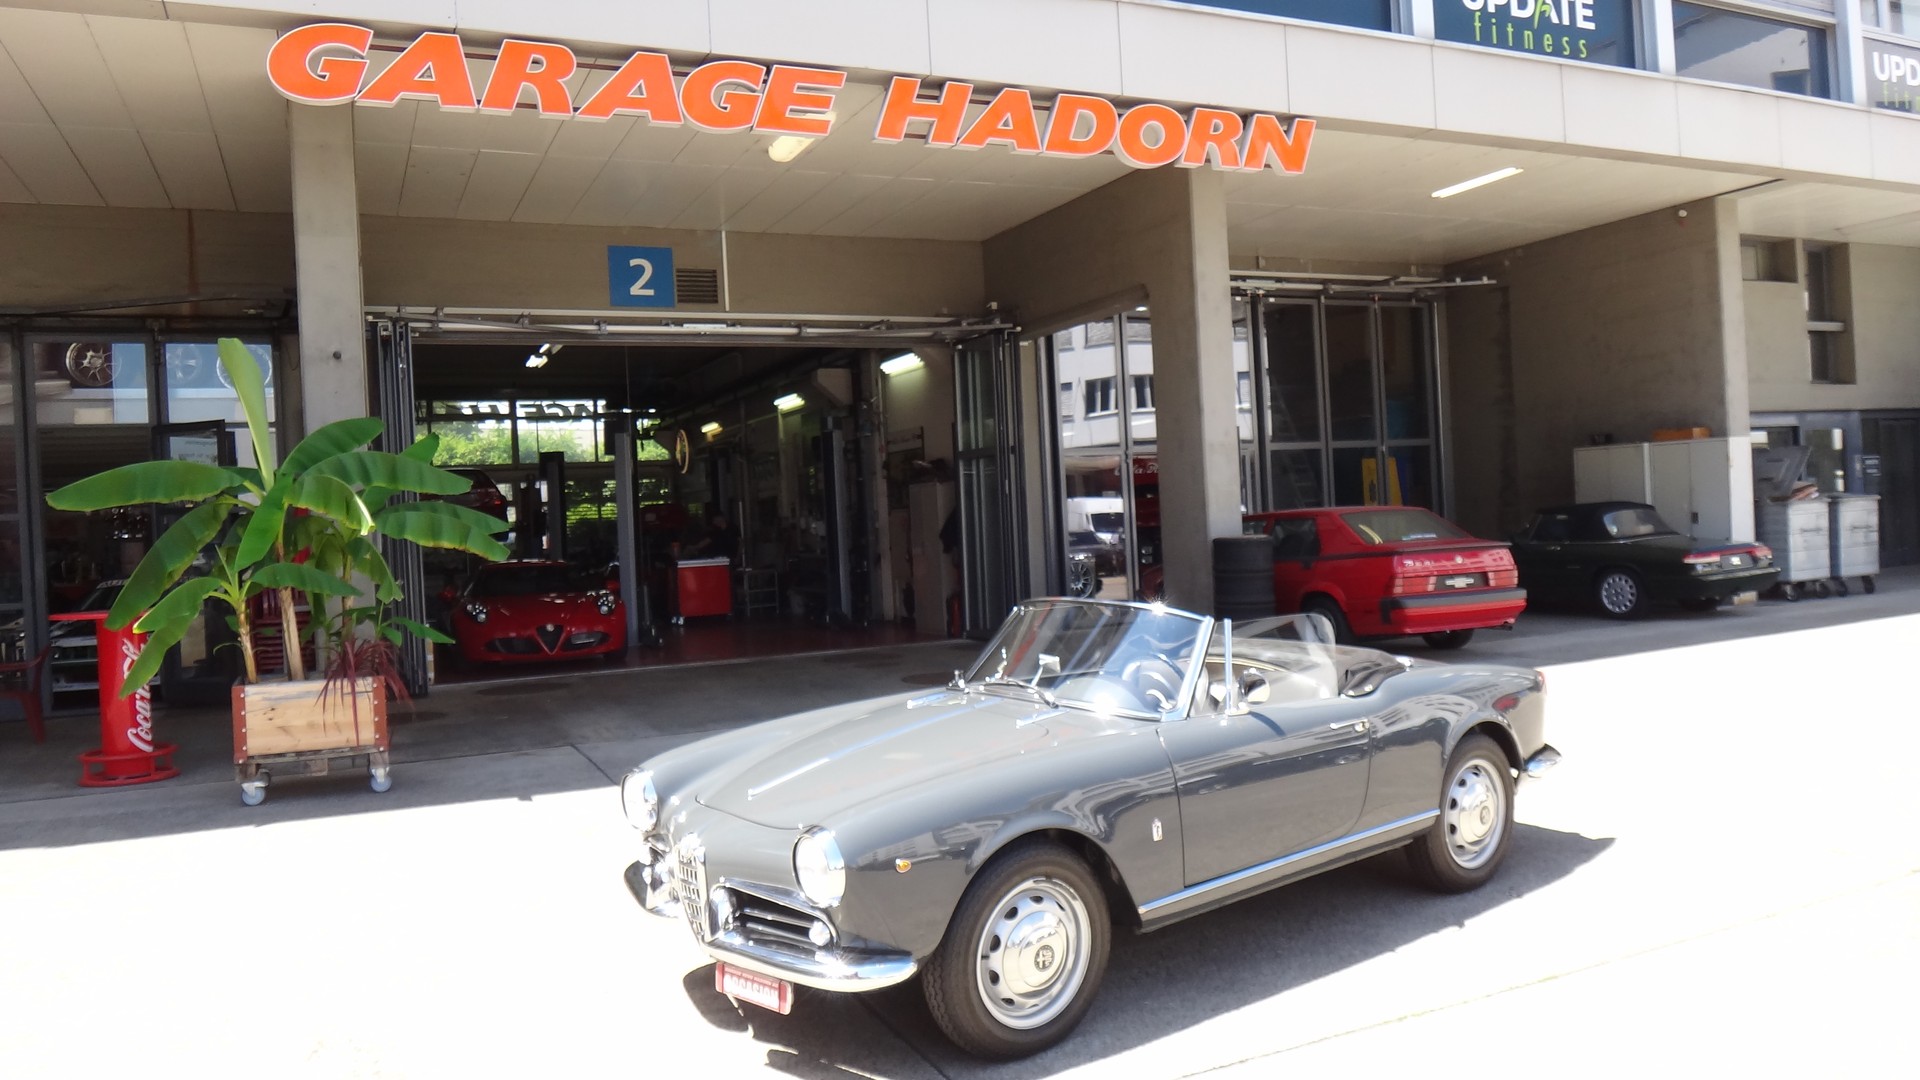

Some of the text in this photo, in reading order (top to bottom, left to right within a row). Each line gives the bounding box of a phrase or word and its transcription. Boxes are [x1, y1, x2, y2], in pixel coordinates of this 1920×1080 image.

[1474, 11, 1588, 59] fitness
[266, 22, 1317, 176] GARAGE HADORN
[629, 257, 655, 296] 2
